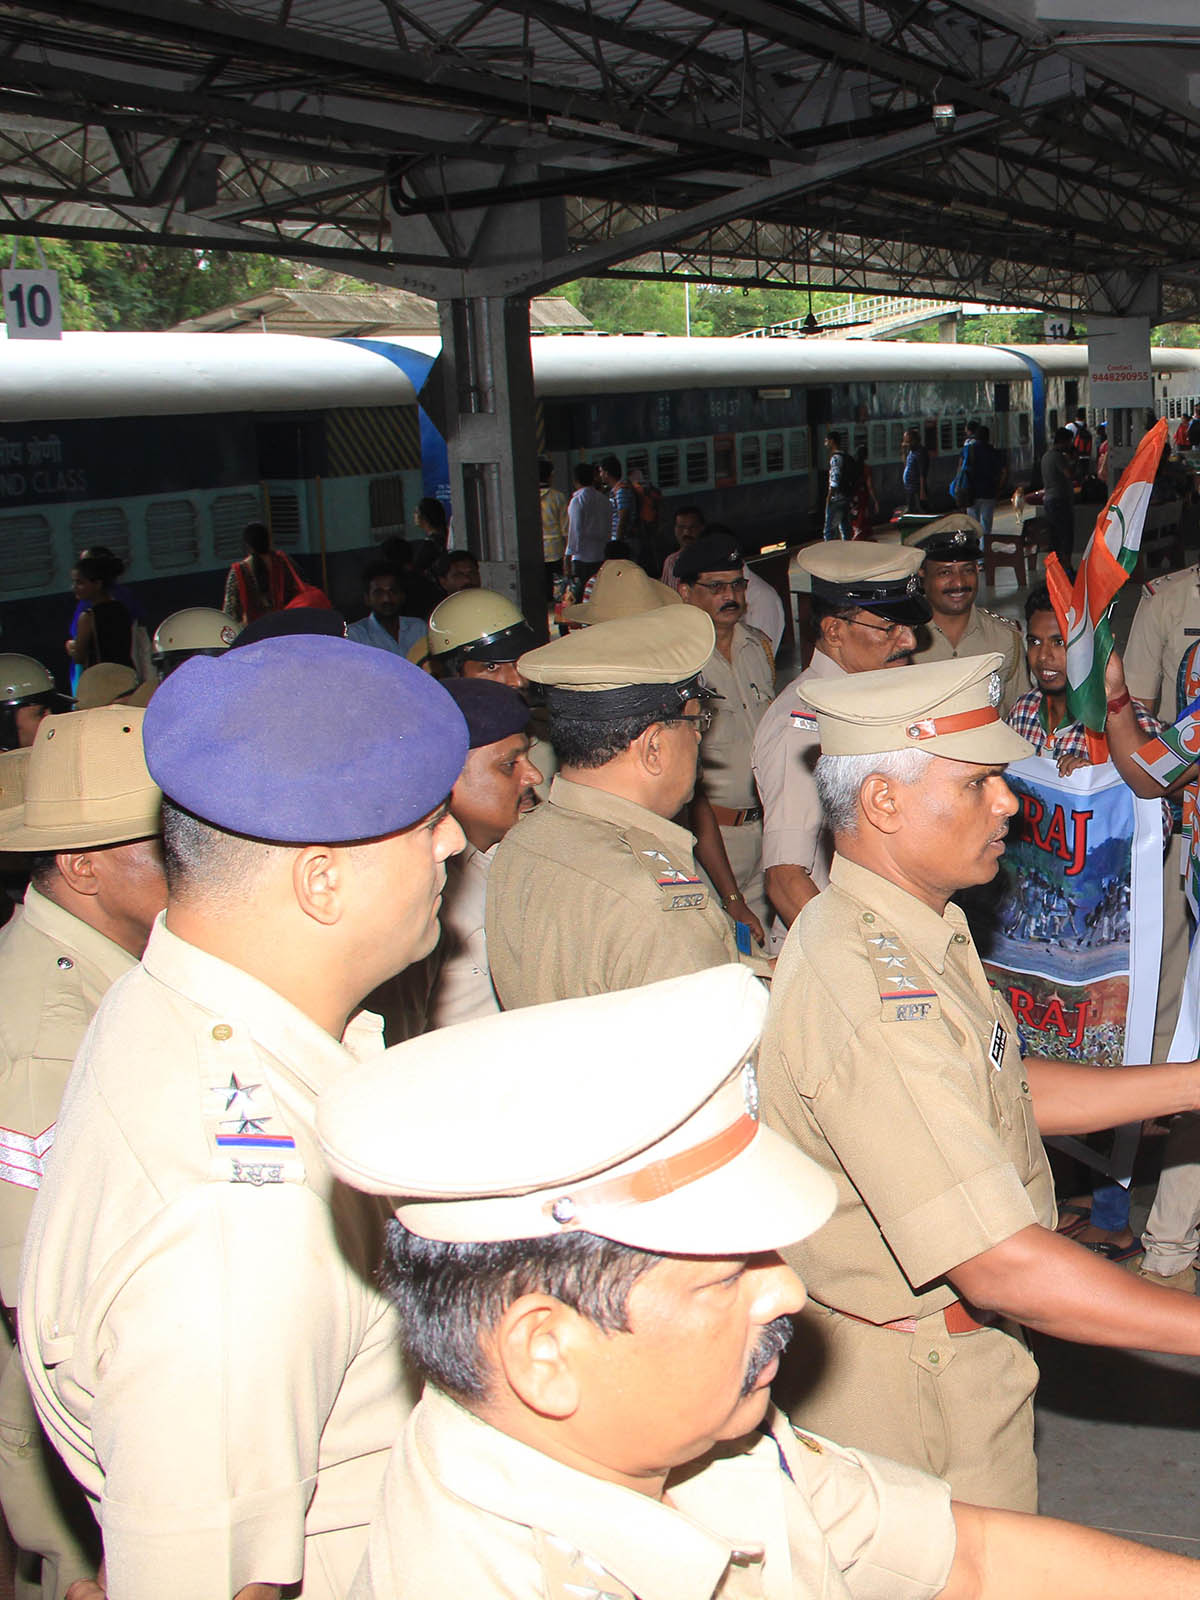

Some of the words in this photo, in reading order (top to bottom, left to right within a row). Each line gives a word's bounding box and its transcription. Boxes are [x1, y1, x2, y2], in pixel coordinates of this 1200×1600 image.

[8, 283, 52, 328] 10
[1019, 793, 1094, 876] RAJ
[1008, 986, 1092, 1049] RAJ
